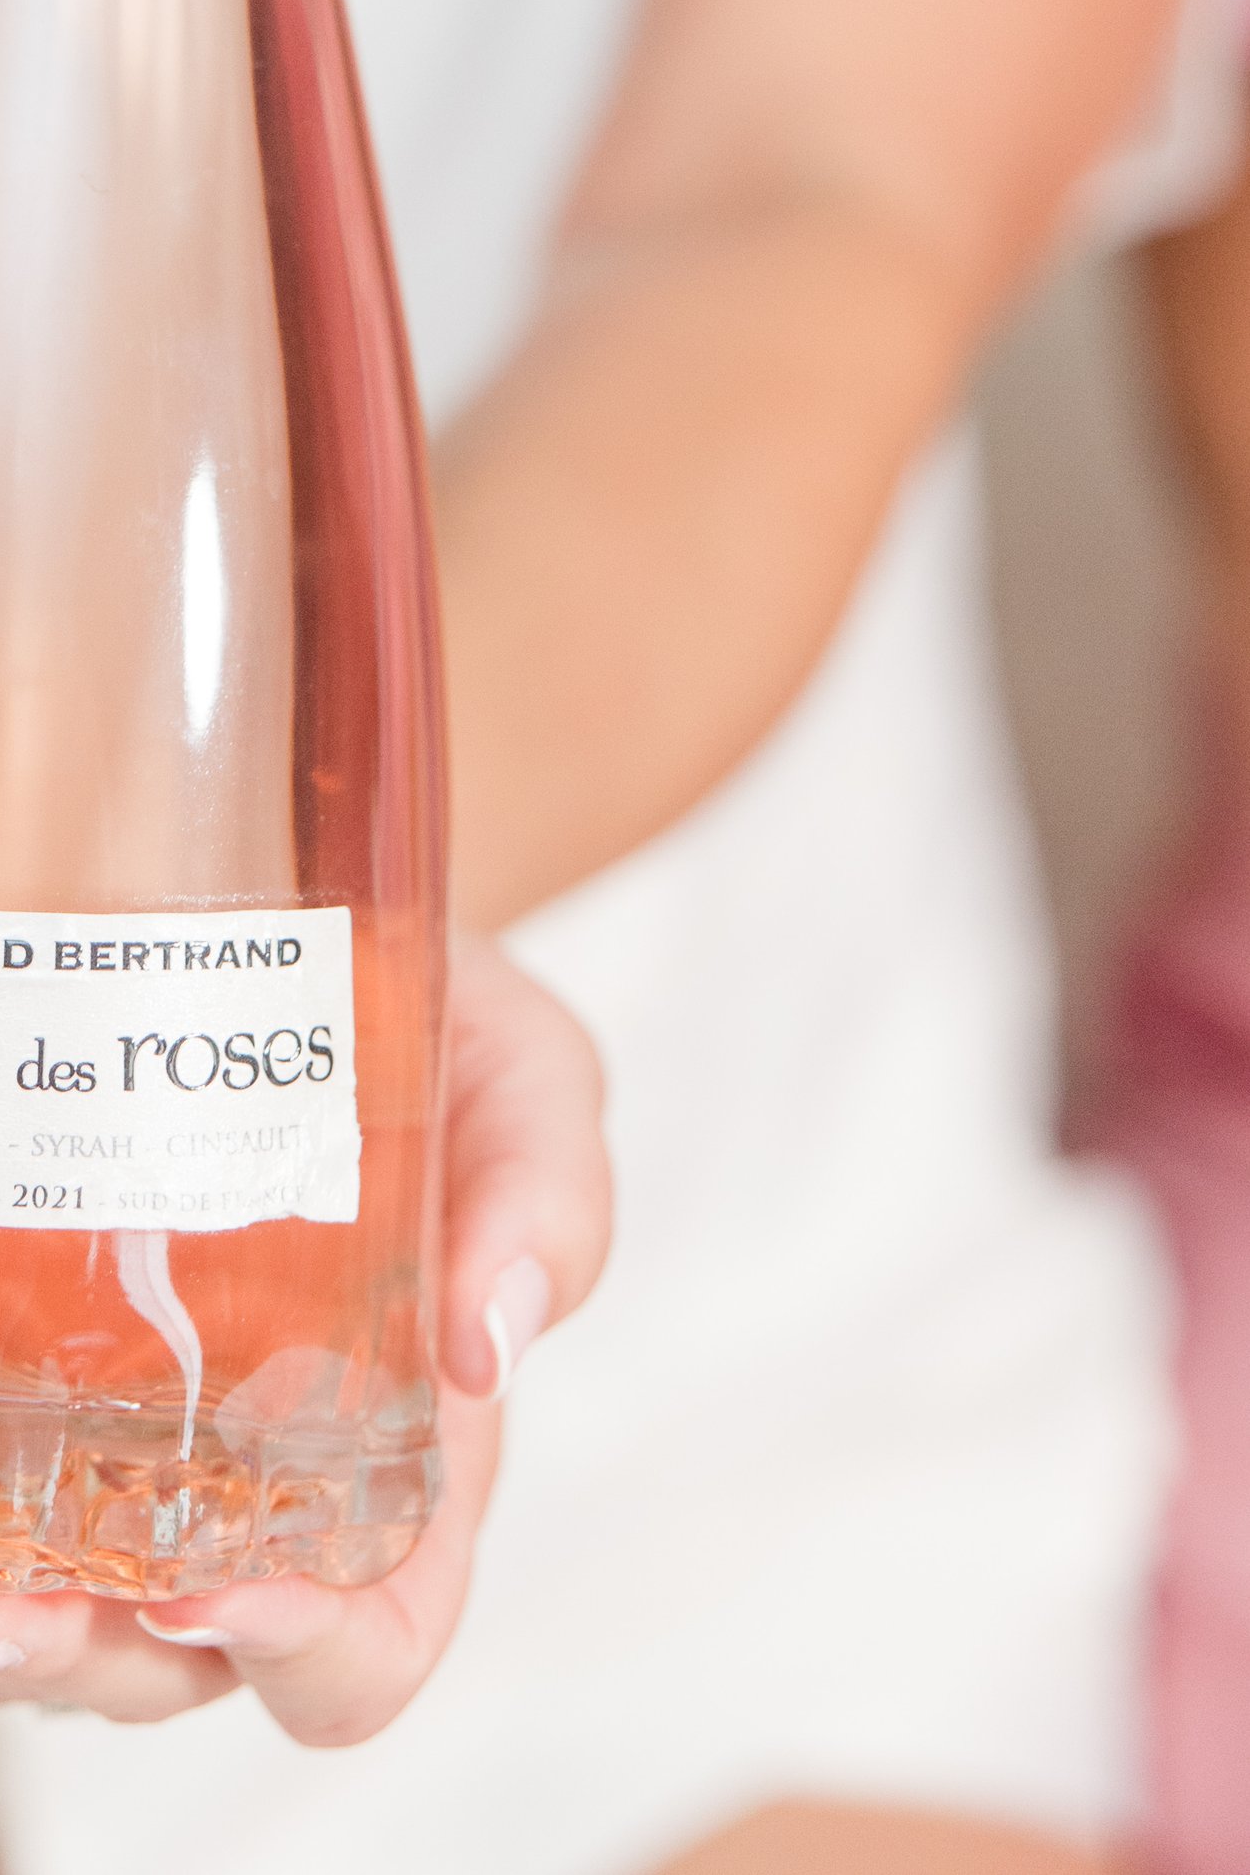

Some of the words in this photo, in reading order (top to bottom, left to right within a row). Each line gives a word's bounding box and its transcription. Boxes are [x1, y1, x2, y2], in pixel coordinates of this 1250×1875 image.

[54, 937, 302, 971] BERTRAND
[16, 1036, 97, 1093] des
[117, 1025, 334, 1092] roses
[30, 1133, 134, 1159] SYRAH
[165, 1124, 302, 1158] CINSAULT
[11, 1183, 85, 1210] 2021
[117, 1191, 168, 1212] SUD
[180, 1192, 211, 1213] DE
